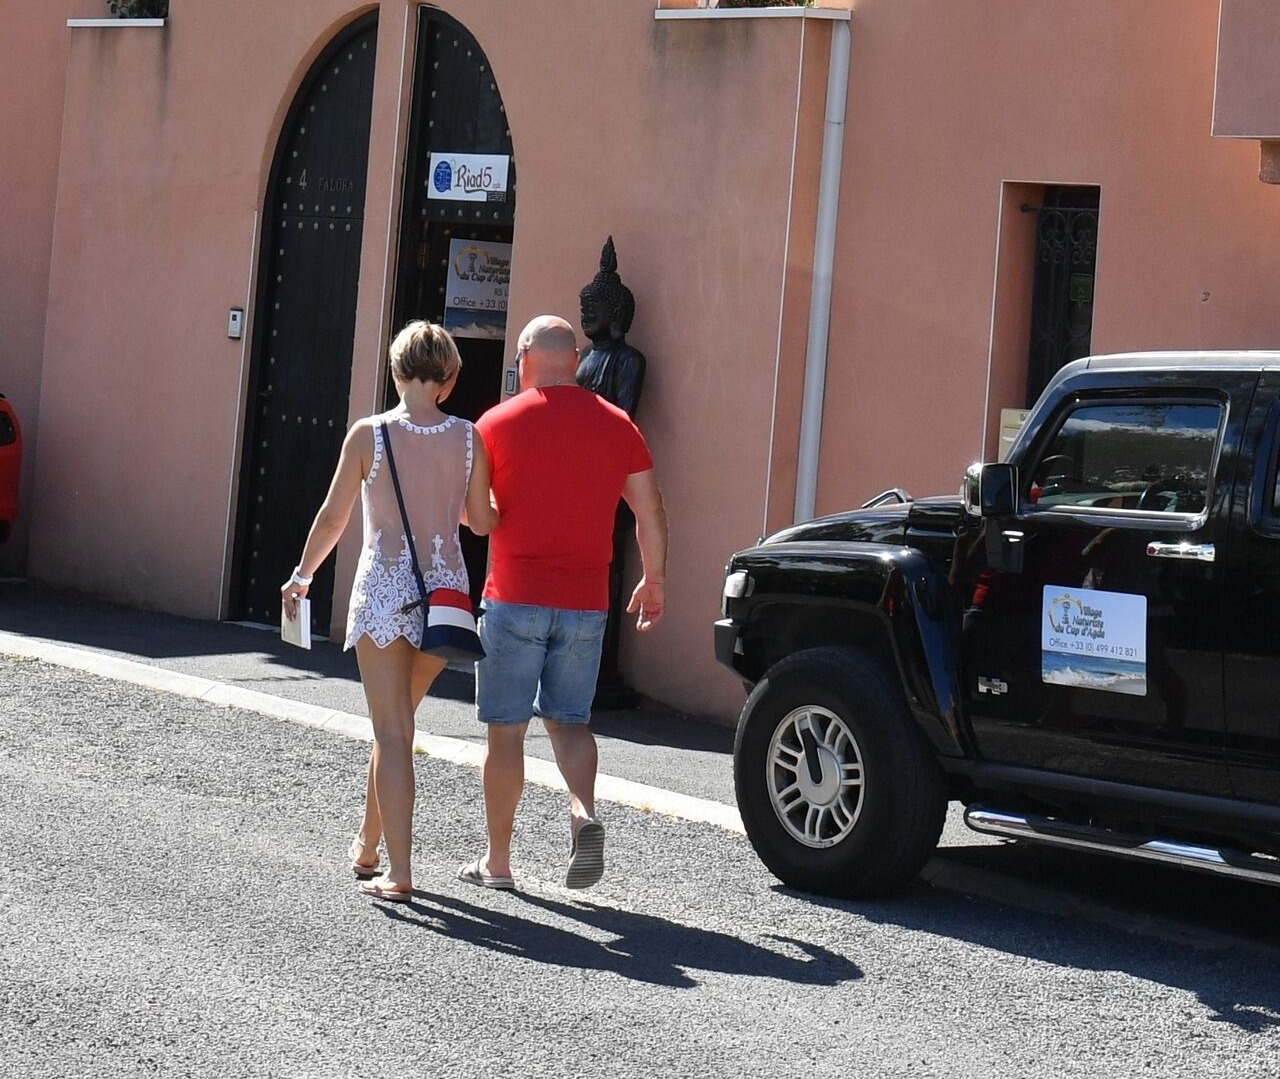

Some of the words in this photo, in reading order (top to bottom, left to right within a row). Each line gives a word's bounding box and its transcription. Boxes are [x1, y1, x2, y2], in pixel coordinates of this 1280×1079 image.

[453, 296, 476, 306] Office
[480, 298, 496, 308] +33
[1080, 604, 1102, 618] Village
[1072, 615, 1104, 628] Naturiste
[1055, 625, 1065, 634] du
[1066, 625, 1080, 637] Cap
[1049, 637, 1068, 649] Office
[1070, 640, 1084, 651] +33
[1085, 641, 1094, 654] (0)
[1096, 642, 1109, 654] 499
[1111, 646, 1123, 656] 412
[1125, 647, 1138, 658] 821
